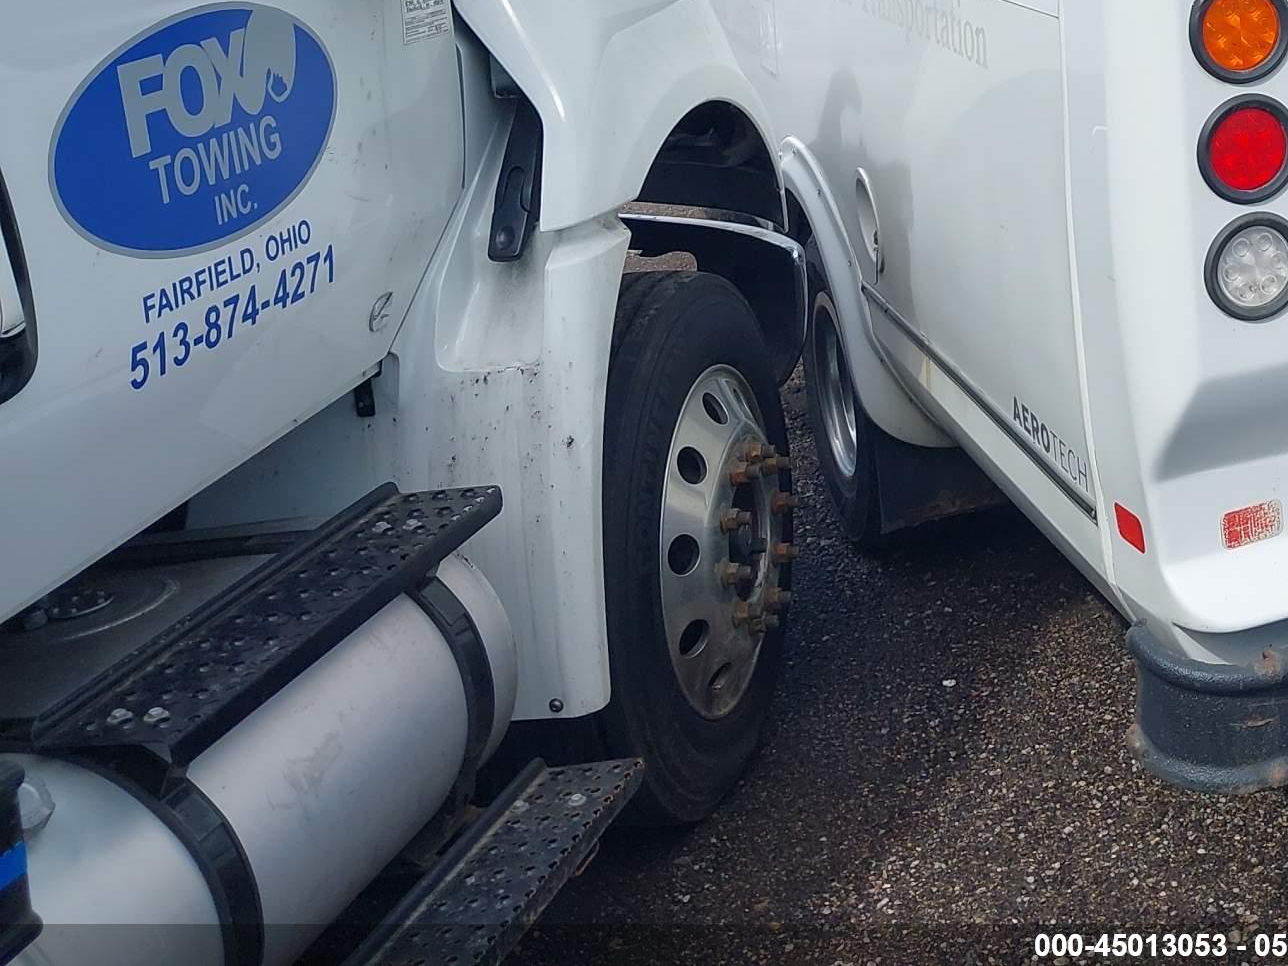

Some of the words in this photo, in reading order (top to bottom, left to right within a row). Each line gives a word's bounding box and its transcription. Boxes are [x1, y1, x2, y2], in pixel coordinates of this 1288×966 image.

[117, 17, 287, 159] FOX
[148, 115, 282, 204] TOWING
[213, 184, 258, 225] INC.
[130, 244, 335, 390] 513-874-4271
[142, 245, 261, 324] FAIRFIELD,
[265, 219, 311, 262] OHIO
[1012, 395, 1089, 492] AEROTECH
